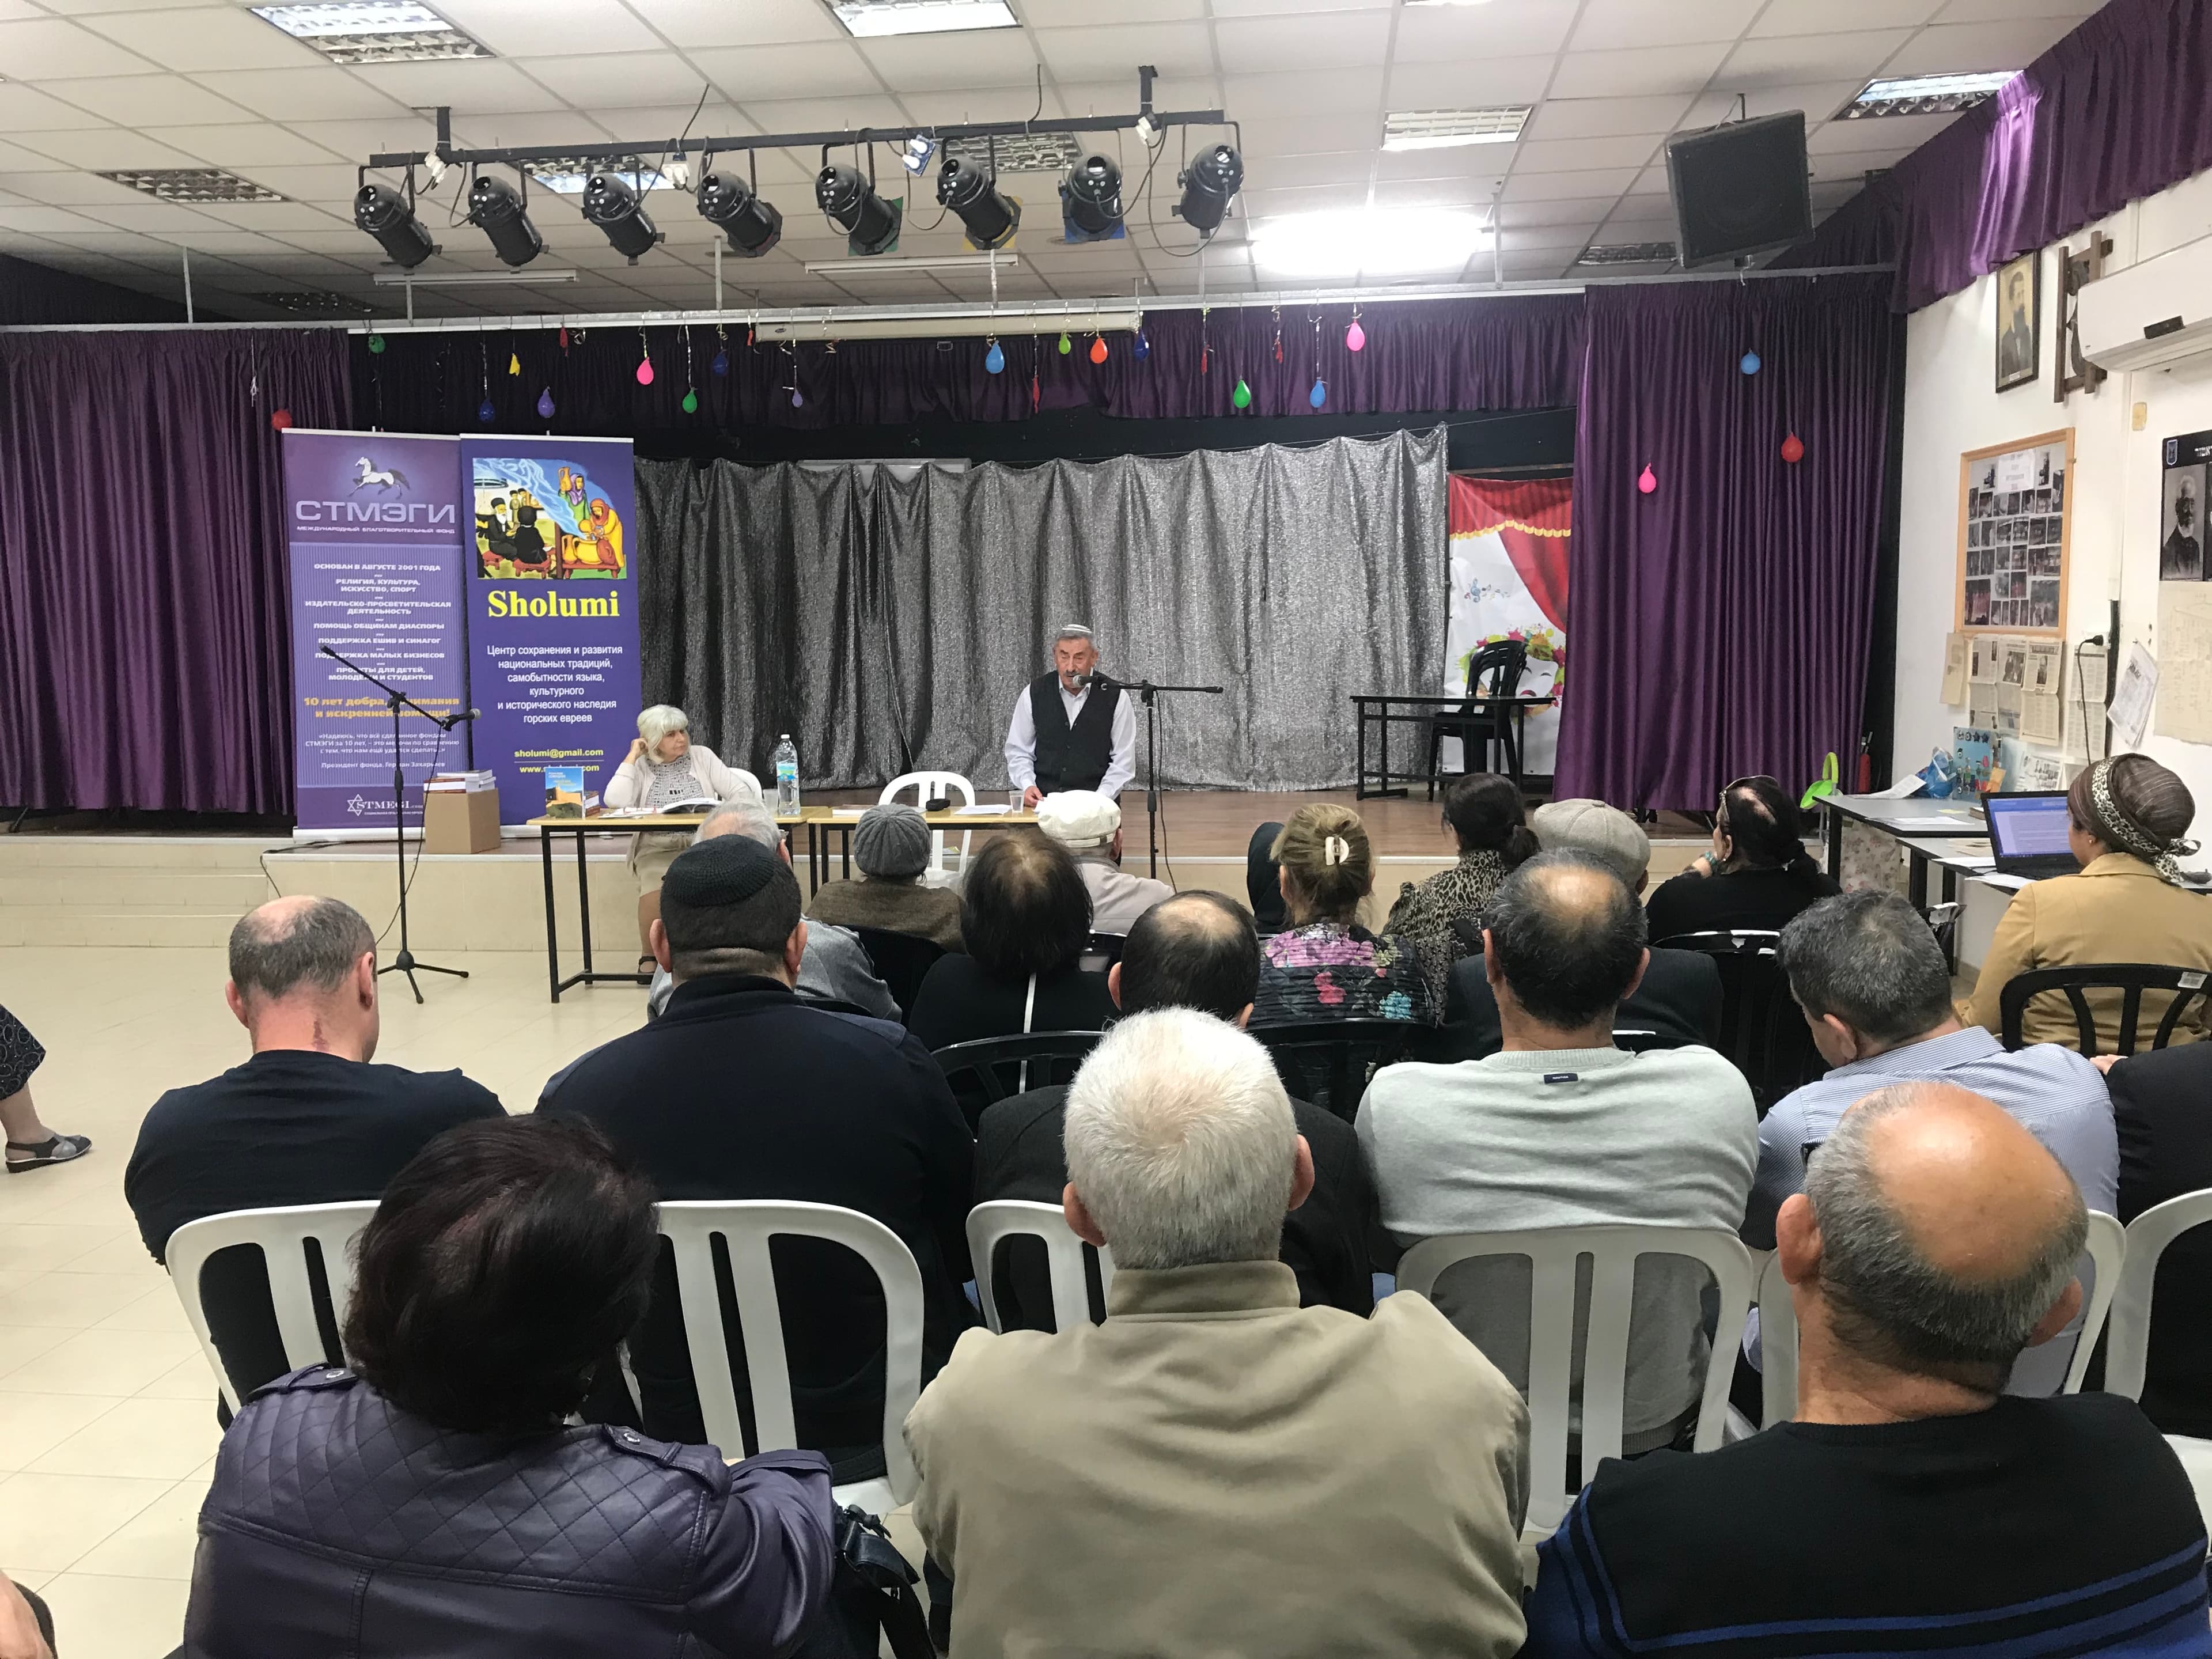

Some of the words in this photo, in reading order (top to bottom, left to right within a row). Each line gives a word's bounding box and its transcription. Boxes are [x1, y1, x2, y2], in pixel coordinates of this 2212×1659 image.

[296, 500, 455, 524] СТМЭГИ
[488, 590, 620, 618] Sholumi
[487, 645, 516, 657] Центр
[518, 646, 571, 657] сохранения
[582, 646, 623, 656] развития
[498, 660, 565, 670] национальных
[567, 658, 613, 669] традиций,
[507, 672, 573, 682] самобытности
[575, 673, 605, 682] языка,
[529, 687, 585, 698] культурного
[304, 698, 319, 706] 10
[506, 700, 571, 711] исторического
[574, 700, 617, 710] наследия
[326, 709, 393, 719] искренней
[524, 715, 558, 725] горских
[560, 714, 593, 724] евреев
[514, 748, 604, 759] sholumi@gmail.com
